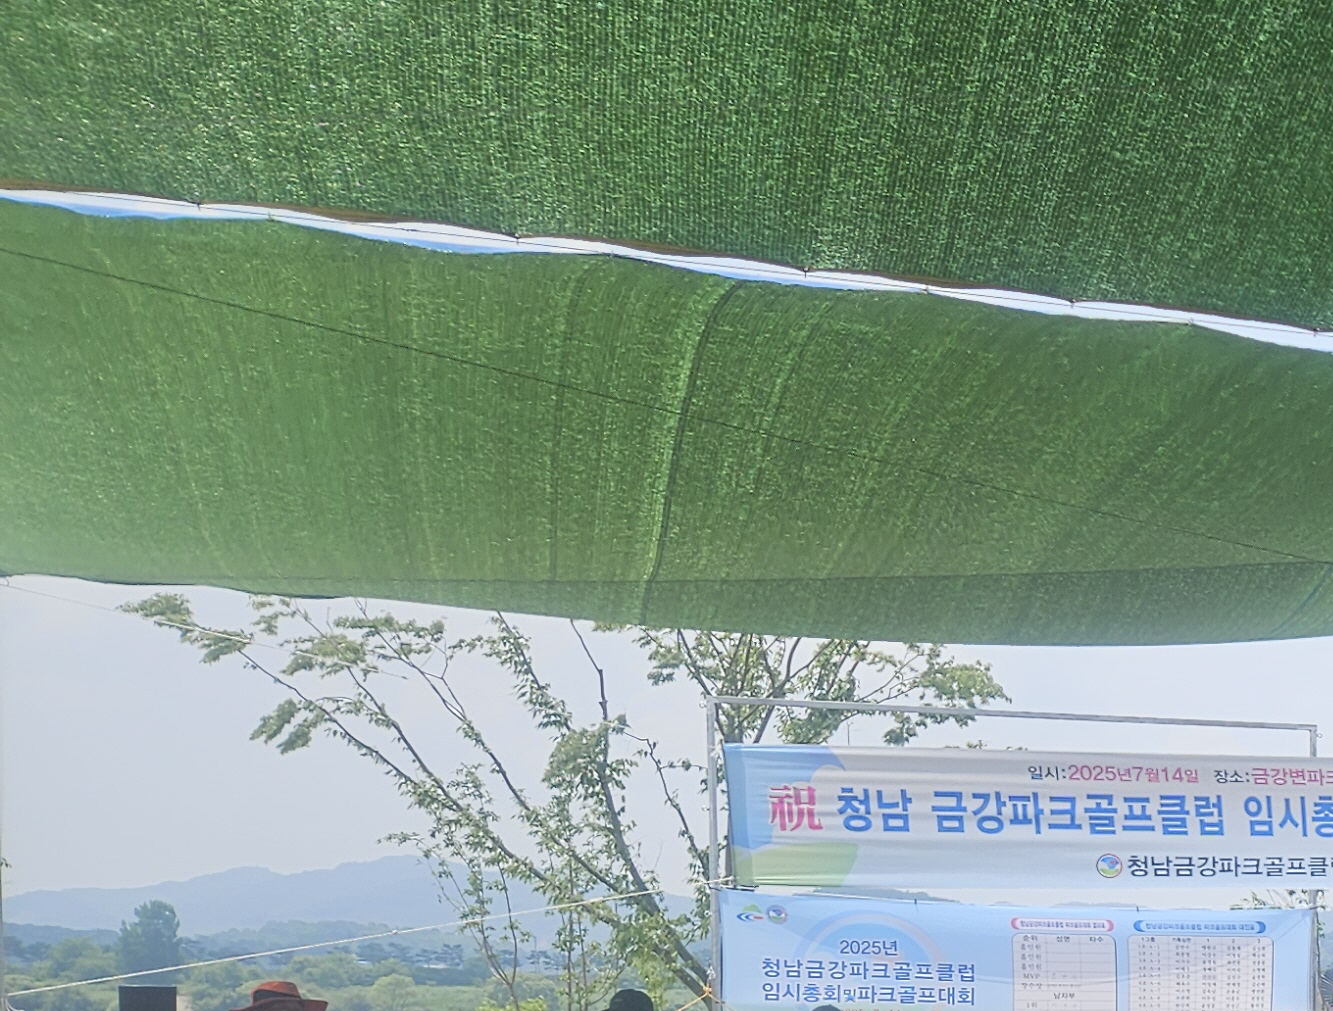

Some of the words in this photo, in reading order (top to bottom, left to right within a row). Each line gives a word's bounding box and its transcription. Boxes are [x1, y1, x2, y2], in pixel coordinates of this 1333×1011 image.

[768, 785, 823, 832] 祝
[837, 786, 913, 832] 청남
[931, 790, 1225, 836] 금강파크골프클럽
[839, 939, 899, 957] 2025년
[761, 958, 976, 983] 청남금강파크골프클럽
[761, 982, 976, 1006] 임시총회및파크골프대회
